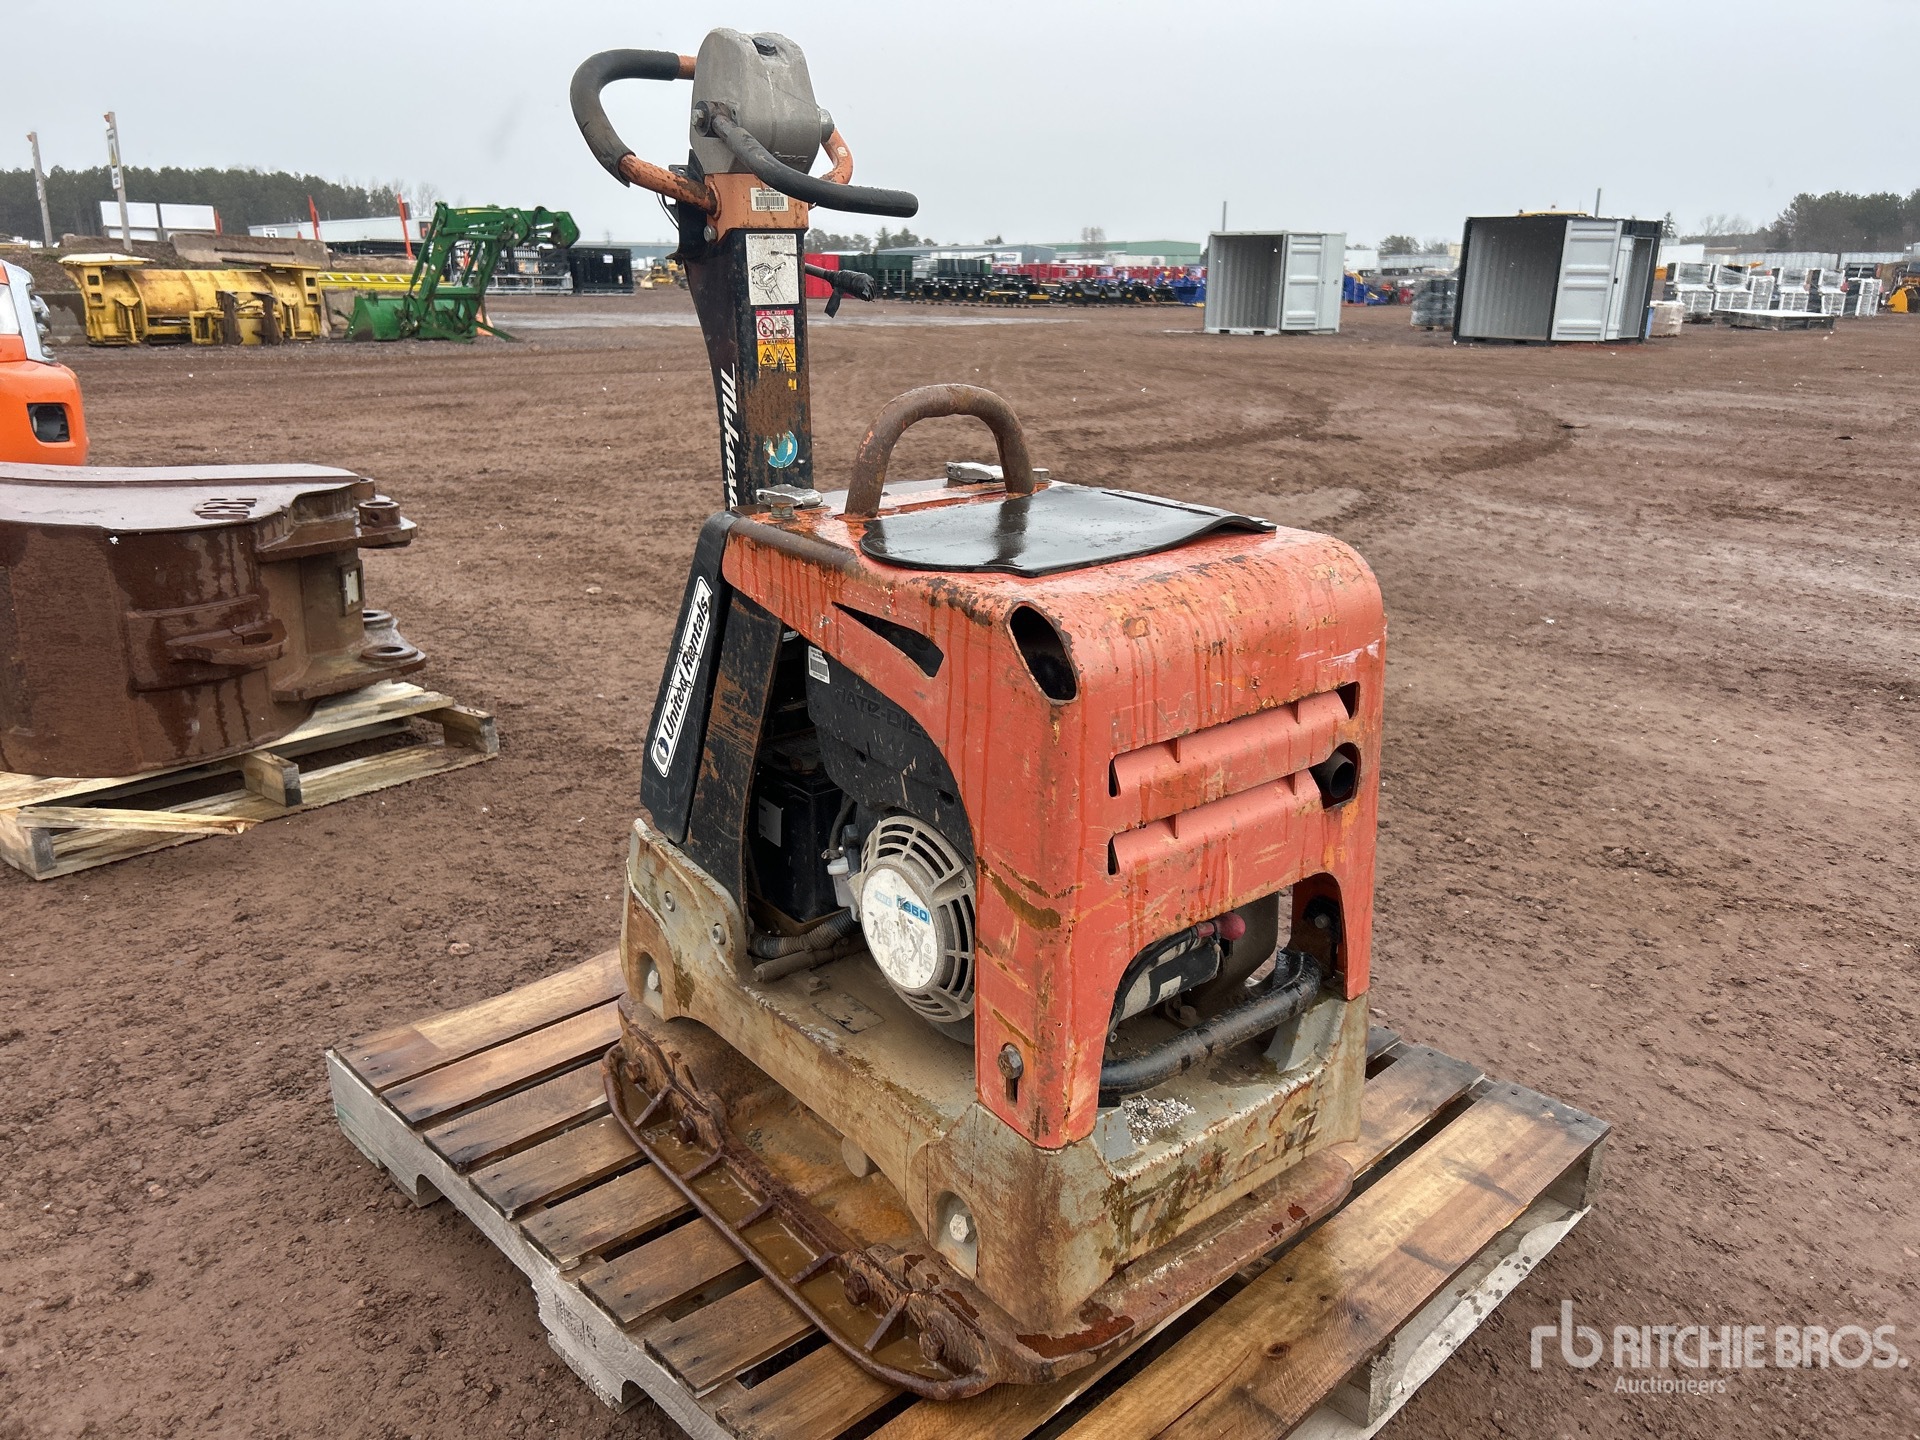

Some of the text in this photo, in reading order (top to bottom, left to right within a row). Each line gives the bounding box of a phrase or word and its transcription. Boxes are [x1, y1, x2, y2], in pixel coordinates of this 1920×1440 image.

[720, 362, 740, 511] Mikasa
[663, 596, 709, 740] United Rentals
